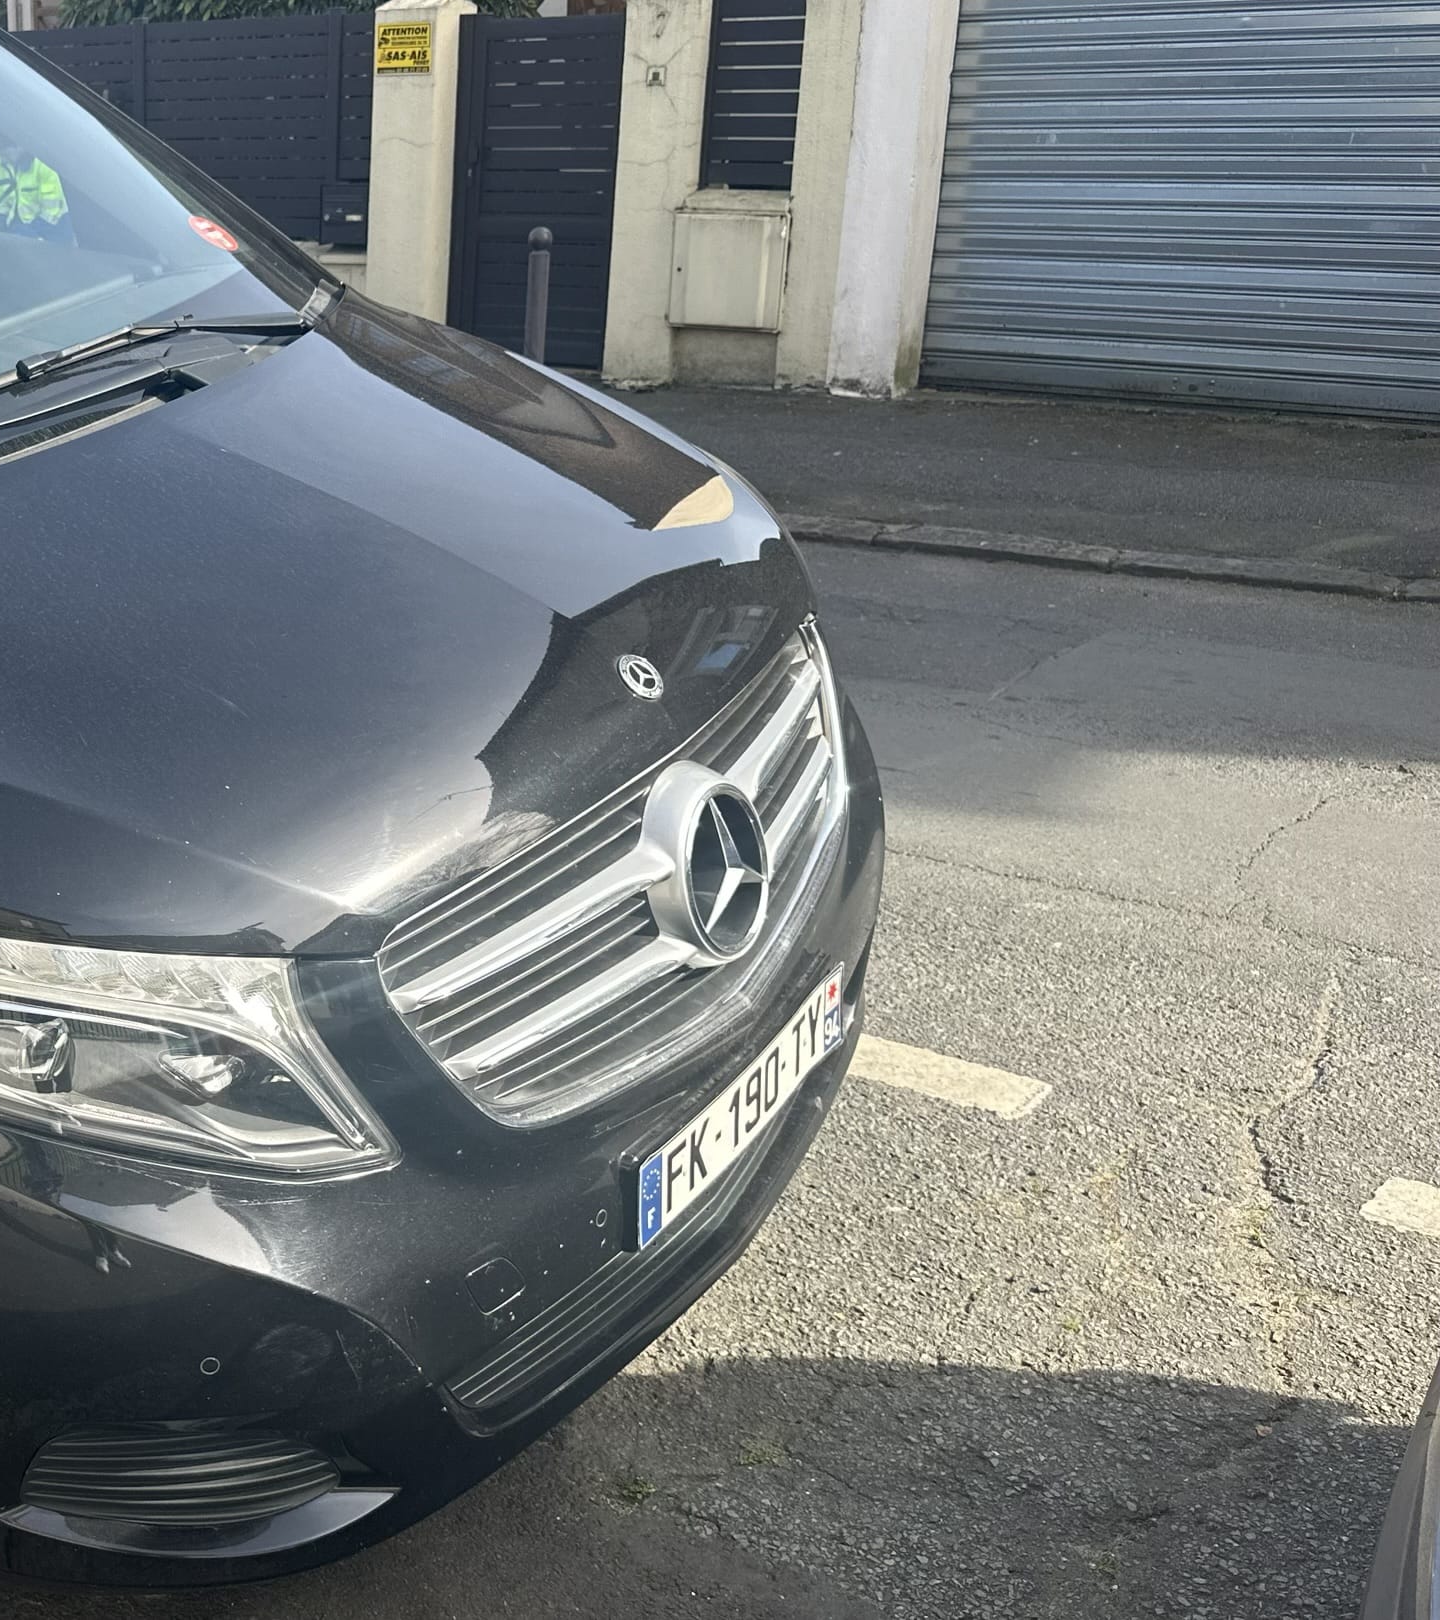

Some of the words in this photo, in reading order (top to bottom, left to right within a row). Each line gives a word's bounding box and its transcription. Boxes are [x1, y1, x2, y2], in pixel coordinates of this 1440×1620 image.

[381, 27, 428, 36] ATTENTION
[824, 1010, 840, 1046] 94
[666, 993, 822, 1214] FK-190-TY
[647, 1207, 656, 1229] F
